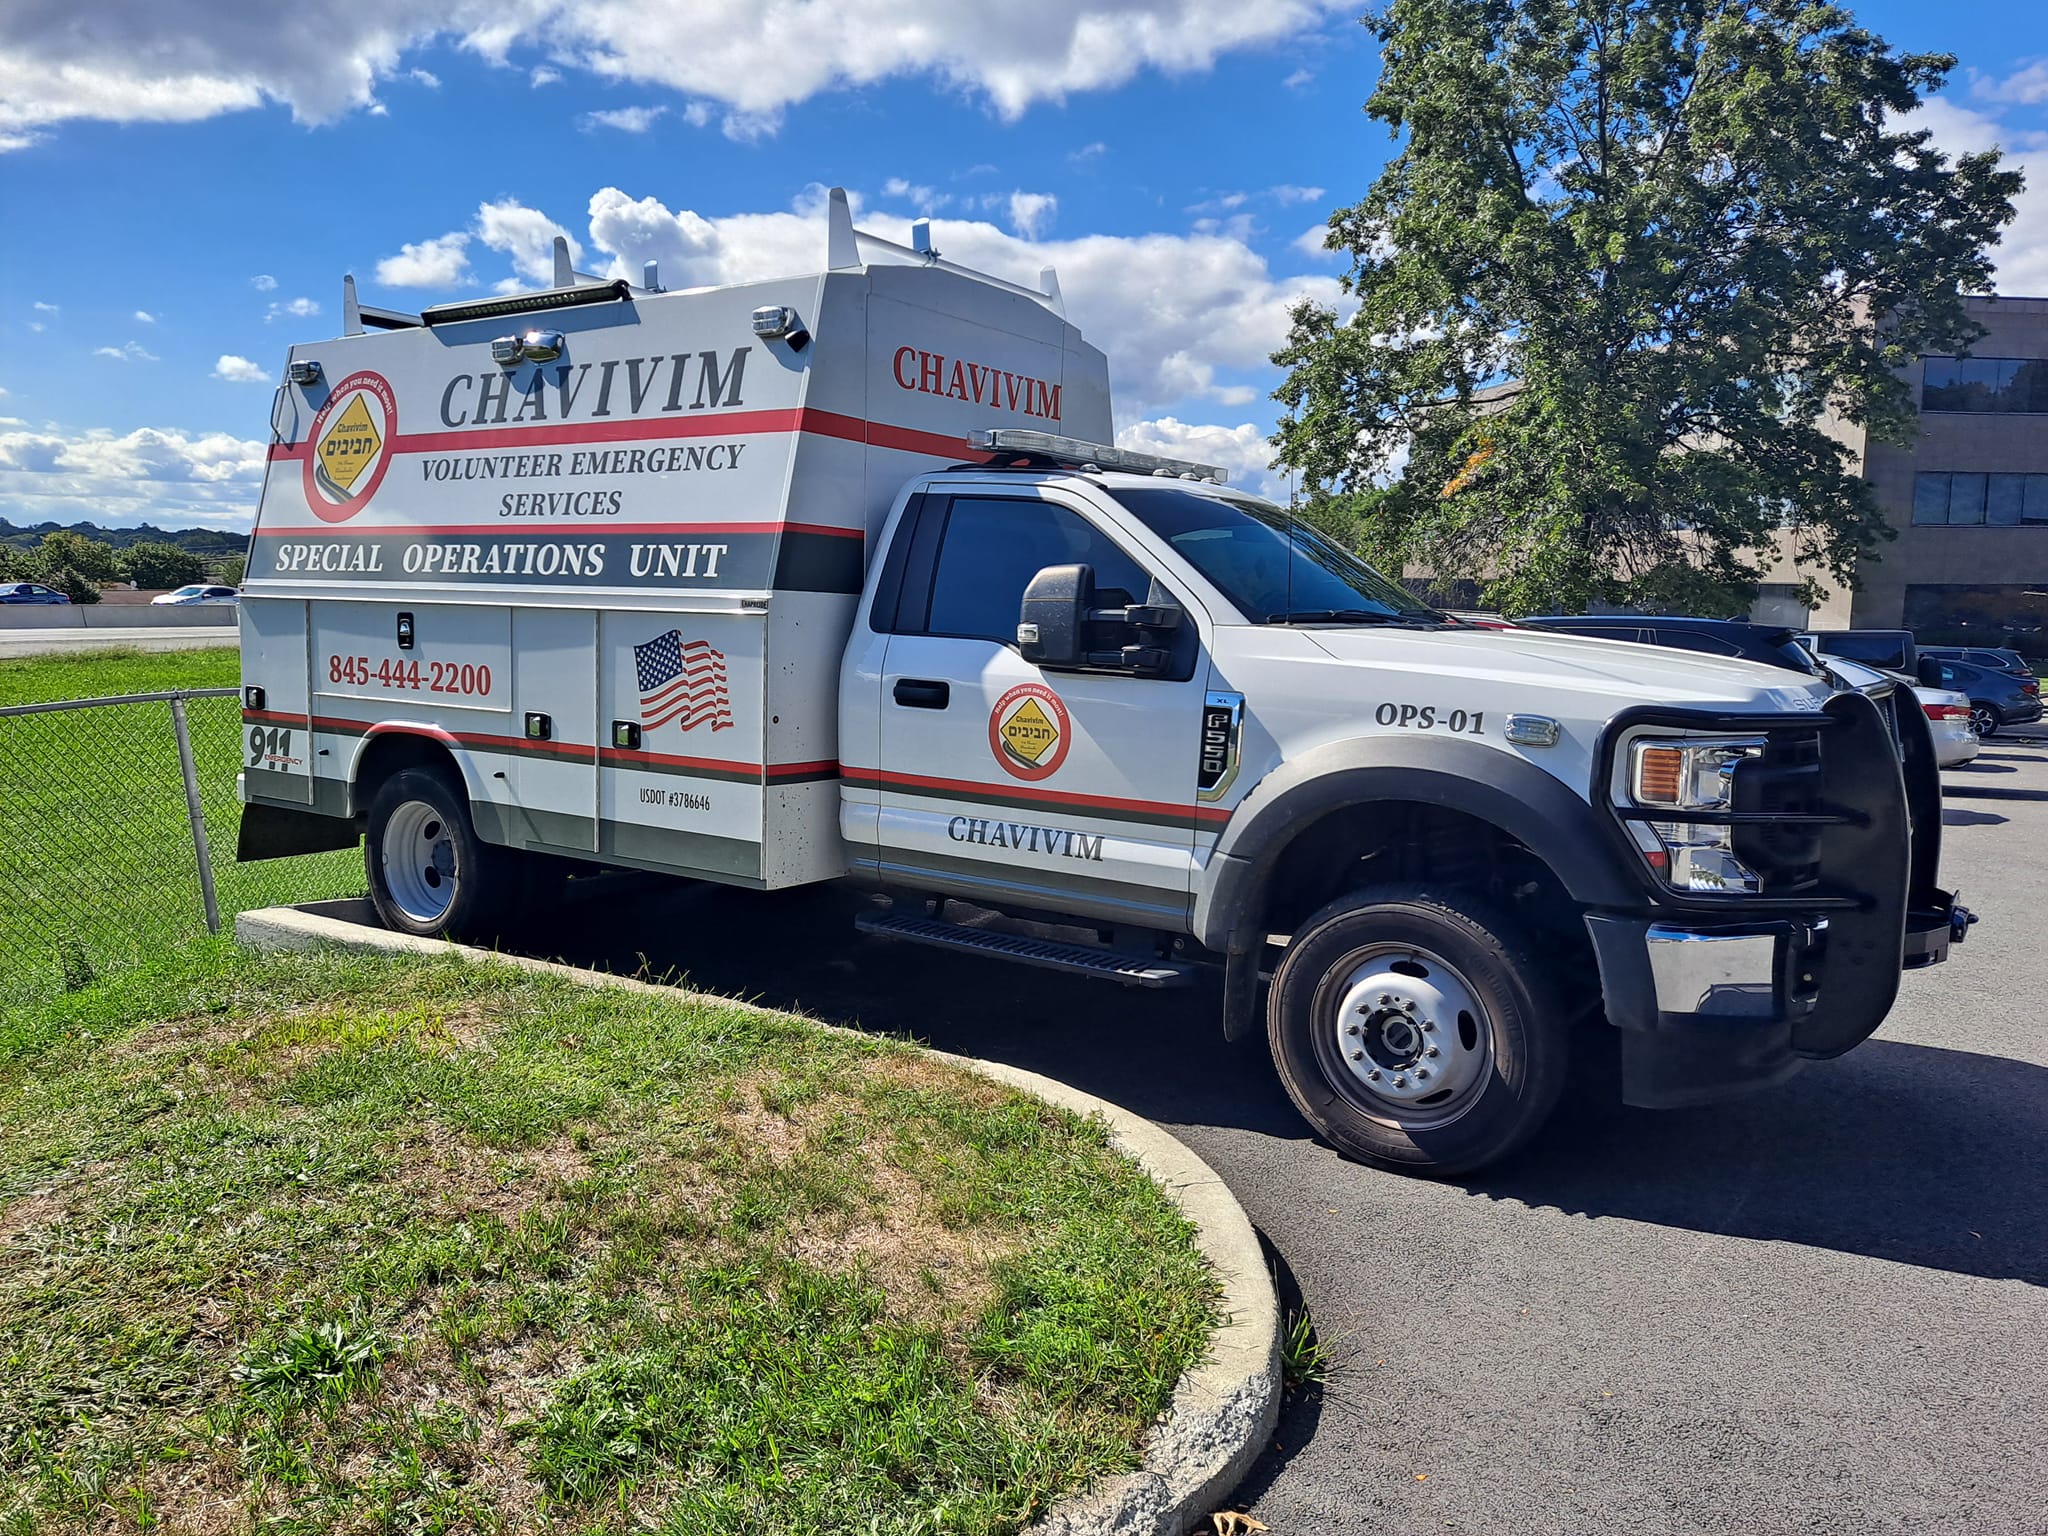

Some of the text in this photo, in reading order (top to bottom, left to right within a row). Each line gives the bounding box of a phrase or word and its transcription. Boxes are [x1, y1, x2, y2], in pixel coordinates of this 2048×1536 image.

[331, 383, 349, 403] when
[349, 377, 363, 389] you
[362, 377, 380, 389] need
[440, 346, 752, 428] CHAVIVIM
[893, 346, 1062, 421] CHAVIVIM
[337, 422, 368, 432] Chavivim
[326, 437, 372, 456] חביבים
[421, 444, 746, 481] VOLUNTEER EMERGENCY
[499, 490, 622, 517] SERVICES
[275, 543, 728, 577] SPECIAL OPERATIONS UNIT
[329, 654, 492, 696] 845-444-2200
[1004, 689, 1021, 701] when
[1032, 687, 1047, 696] need
[1008, 725, 1050, 740] חביבים
[1016, 715, 1044, 724] Chavivim
[1375, 703, 1485, 735] OPS-01
[250, 726, 291, 772] 911
[1203, 713, 1229, 772] F550
[640, 788, 710, 811] USDOT #3786646
[948, 816, 1105, 861] CHAVIVIM
